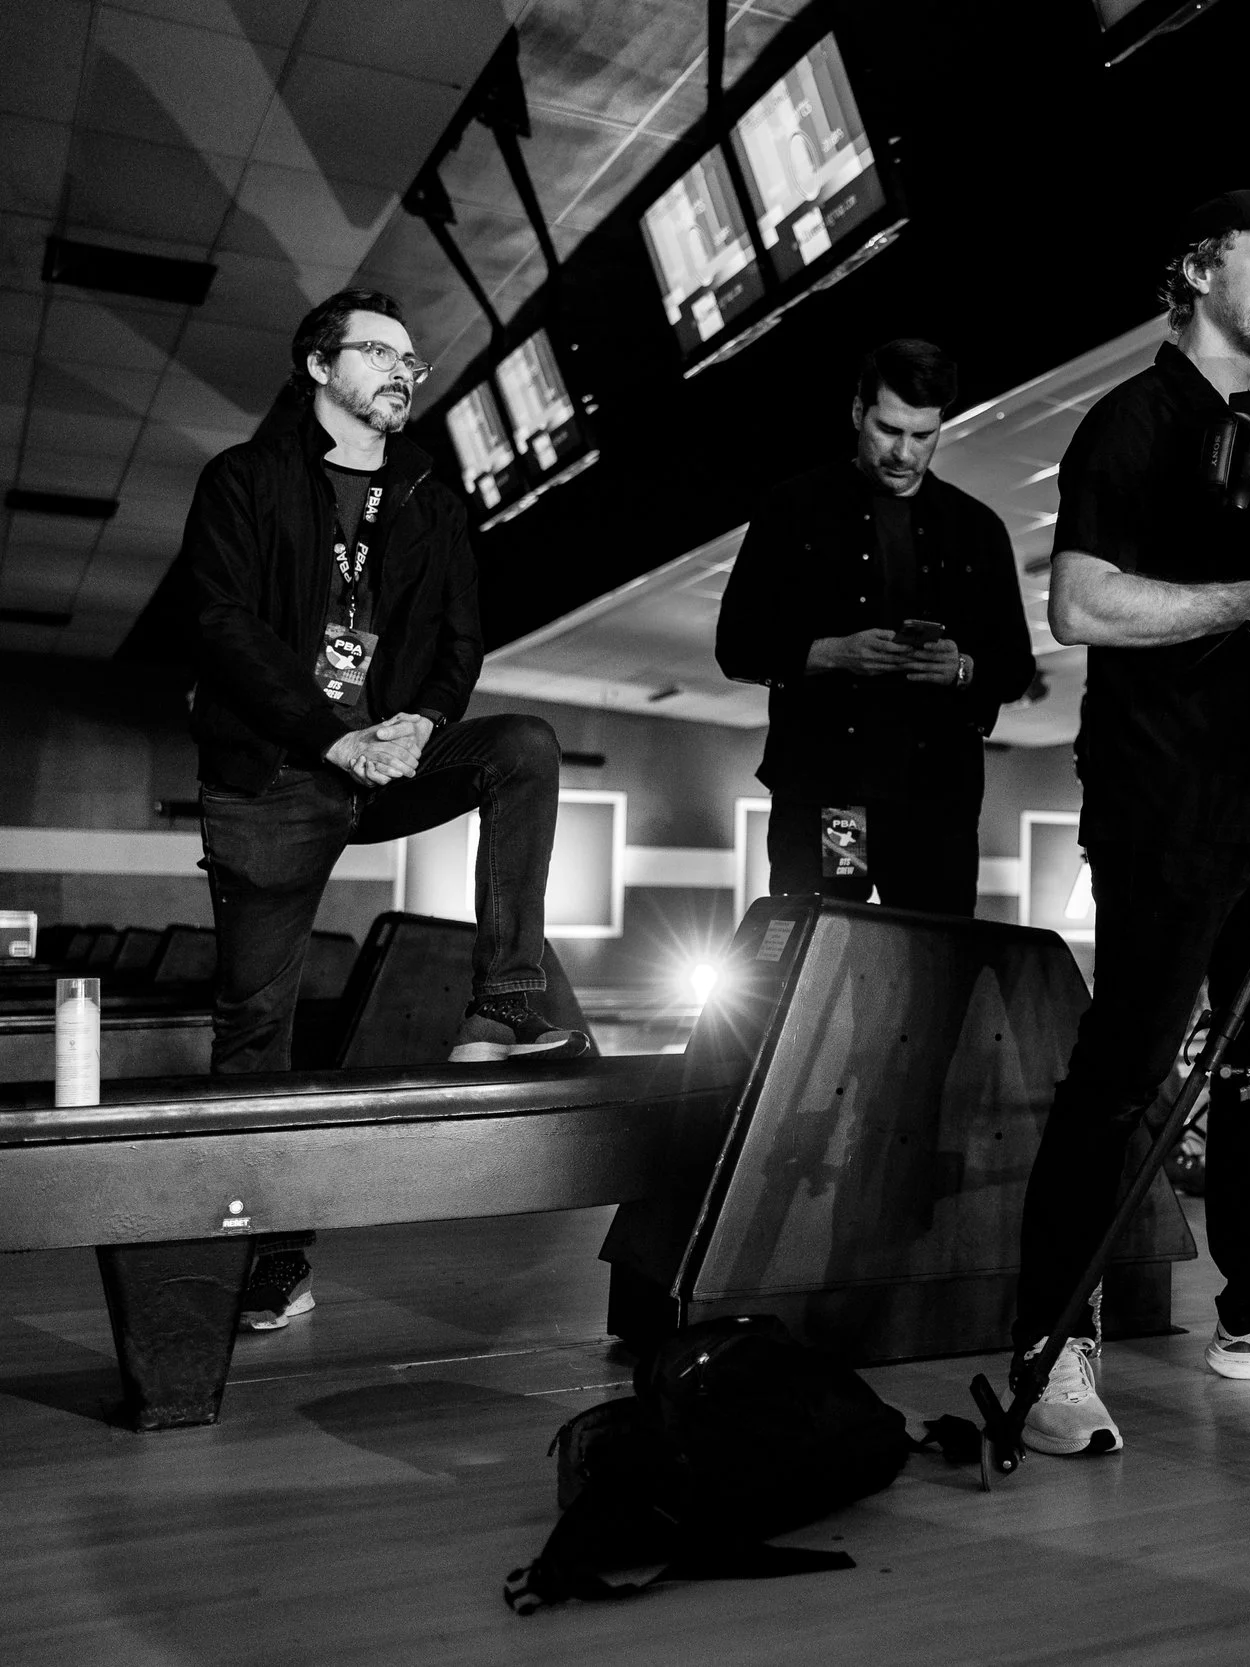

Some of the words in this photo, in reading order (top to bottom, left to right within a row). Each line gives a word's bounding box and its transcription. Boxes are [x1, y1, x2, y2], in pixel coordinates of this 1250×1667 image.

[1211, 435, 1221, 466] SONY
[366, 487, 383, 514] PBA
[355, 542, 369, 572] PBA
[336, 551, 352, 583] PBA
[335, 639, 362, 656] PBA
[327, 680, 343, 690] BTS
[832, 819, 857, 828] PBA
[839, 858, 851, 866] BTS
[223, 1219, 249, 1227] RESET
